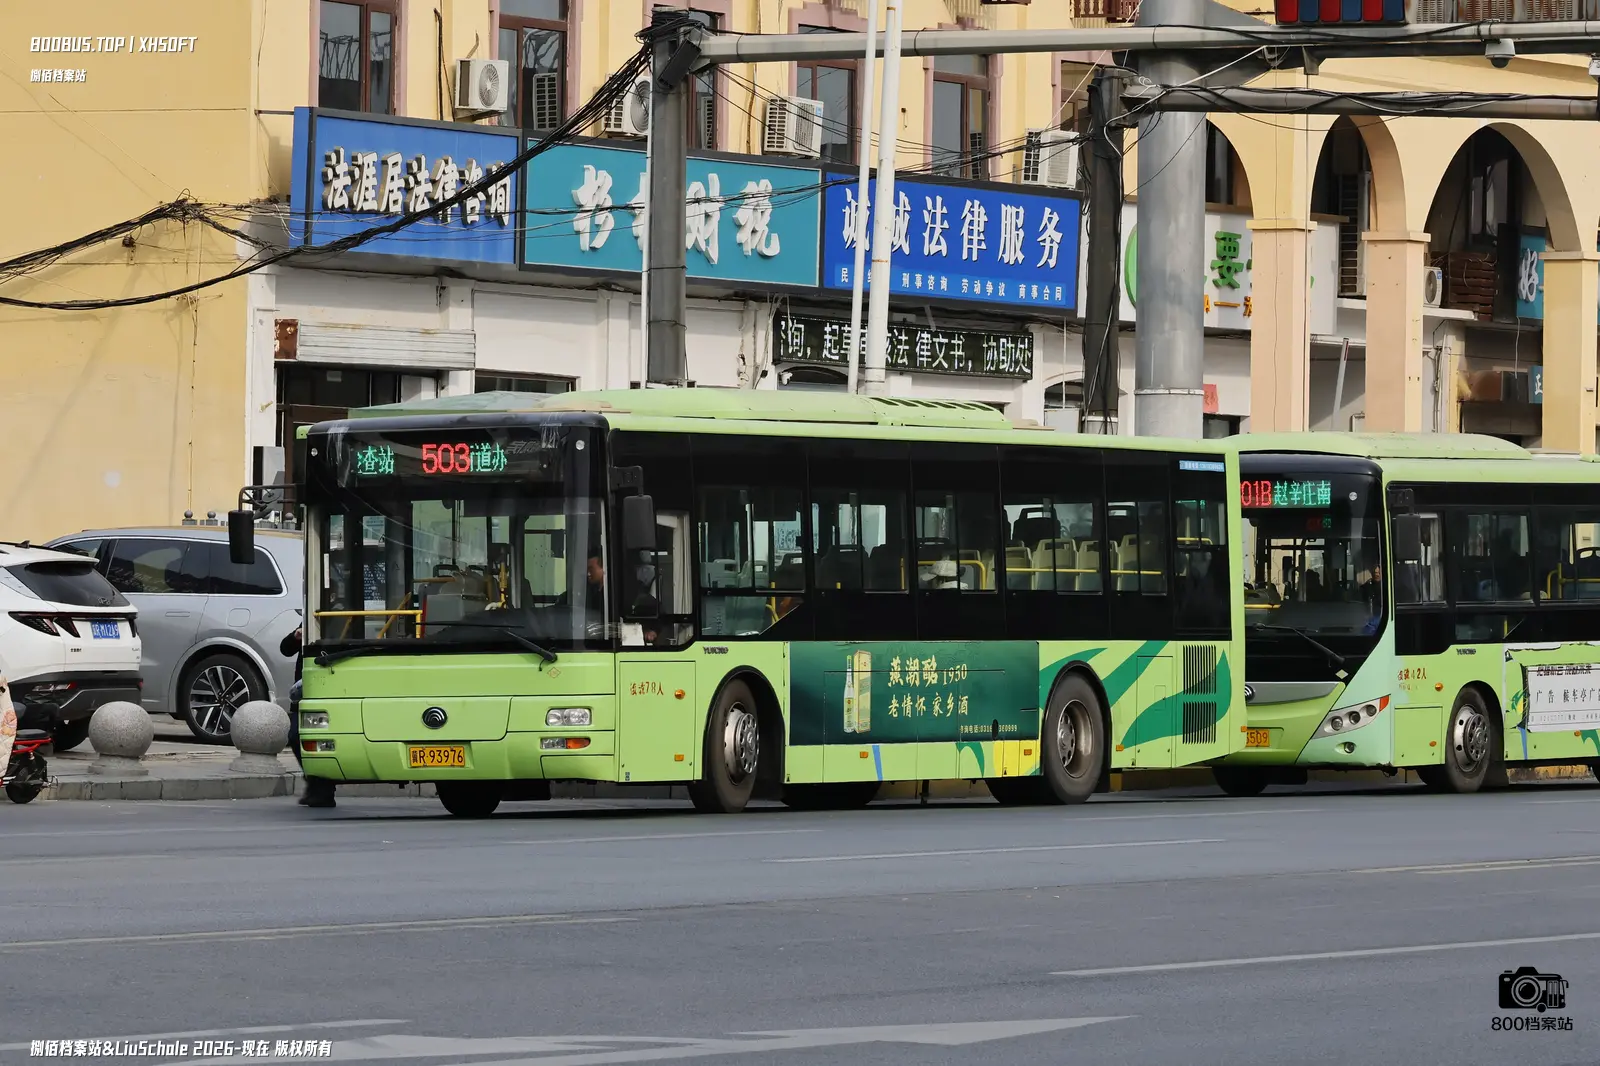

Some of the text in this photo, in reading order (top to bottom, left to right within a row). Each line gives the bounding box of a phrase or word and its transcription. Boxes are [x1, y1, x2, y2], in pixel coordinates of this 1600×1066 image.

[321, 146, 511, 227] 法涯居法律咨询
[901, 272, 1062, 301] 刑事咨询 劳动争议 商事合同
[1518, 248, 1544, 302] 好
[422, 443, 470, 474] 503
[1240, 480, 1271, 505] 01B
[942, 662, 968, 686] 1950
[888, 692, 969, 718] 老情怀 家乡酒
